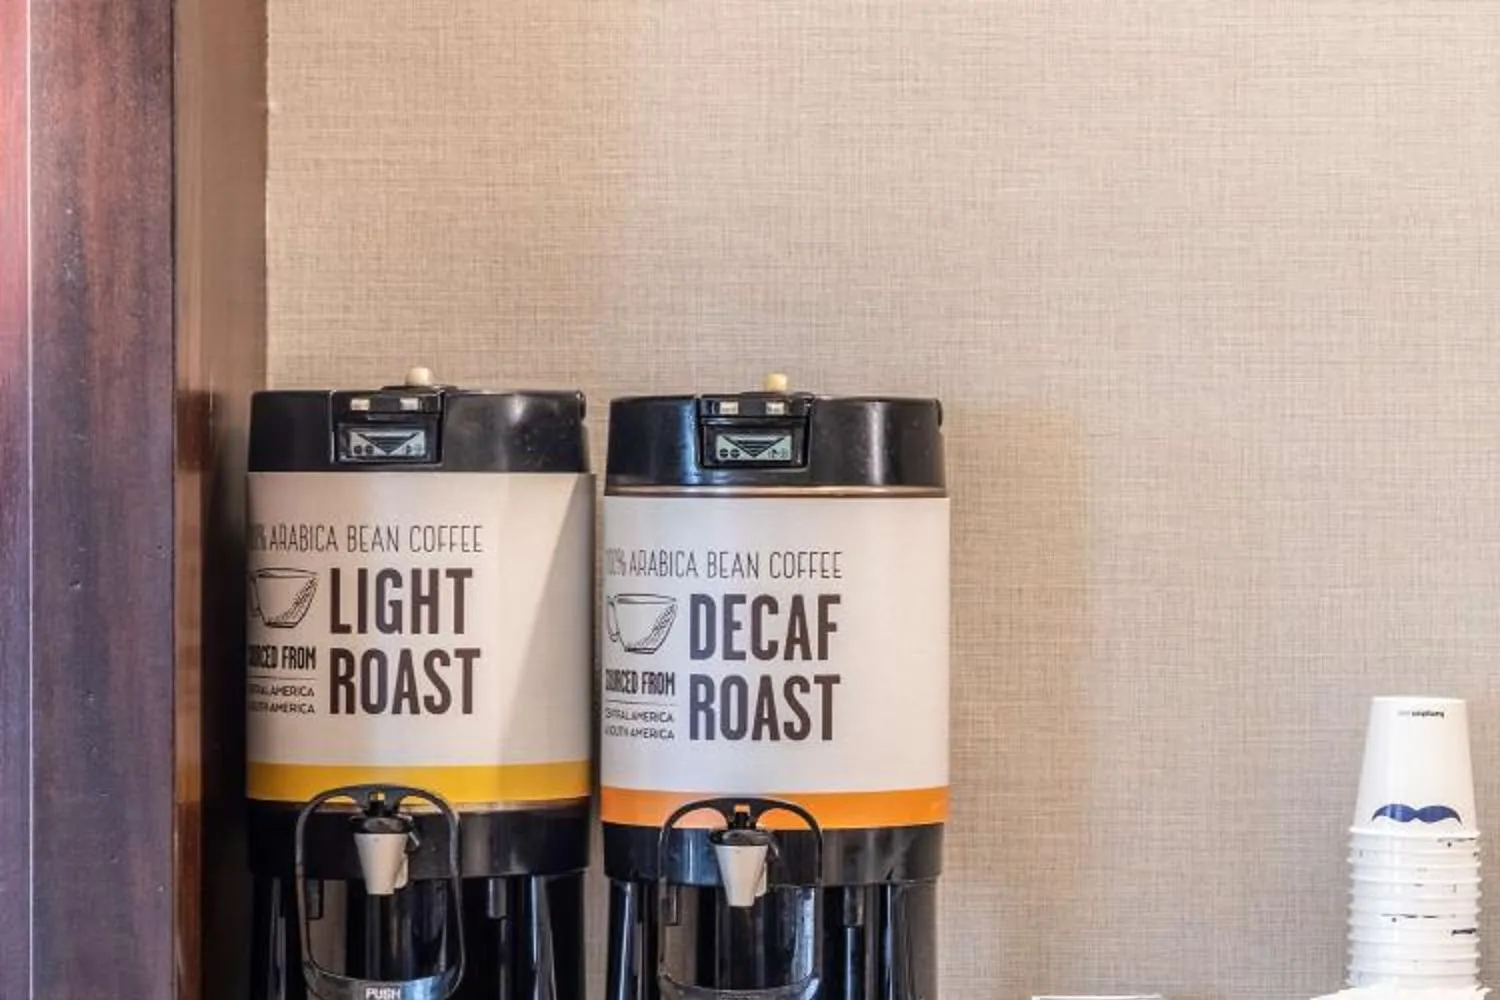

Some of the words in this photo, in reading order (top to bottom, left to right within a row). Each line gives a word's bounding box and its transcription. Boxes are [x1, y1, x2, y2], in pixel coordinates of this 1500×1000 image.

[270, 523, 339, 553] ARABICA
[347, 524, 399, 553] BEAN
[409, 524, 484, 553] COFFEE
[629, 548, 699, 577] ARABICA
[707, 550, 760, 579] BEAN
[769, 550, 843, 580] COFFEE
[329, 567, 473, 635] LIGHT
[689, 593, 842, 661] DECAF
[281, 645, 317, 671] FROM
[329, 647, 481, 715] ROAST
[641, 670, 676, 697] FROM
[689, 673, 841, 741] ROAST
